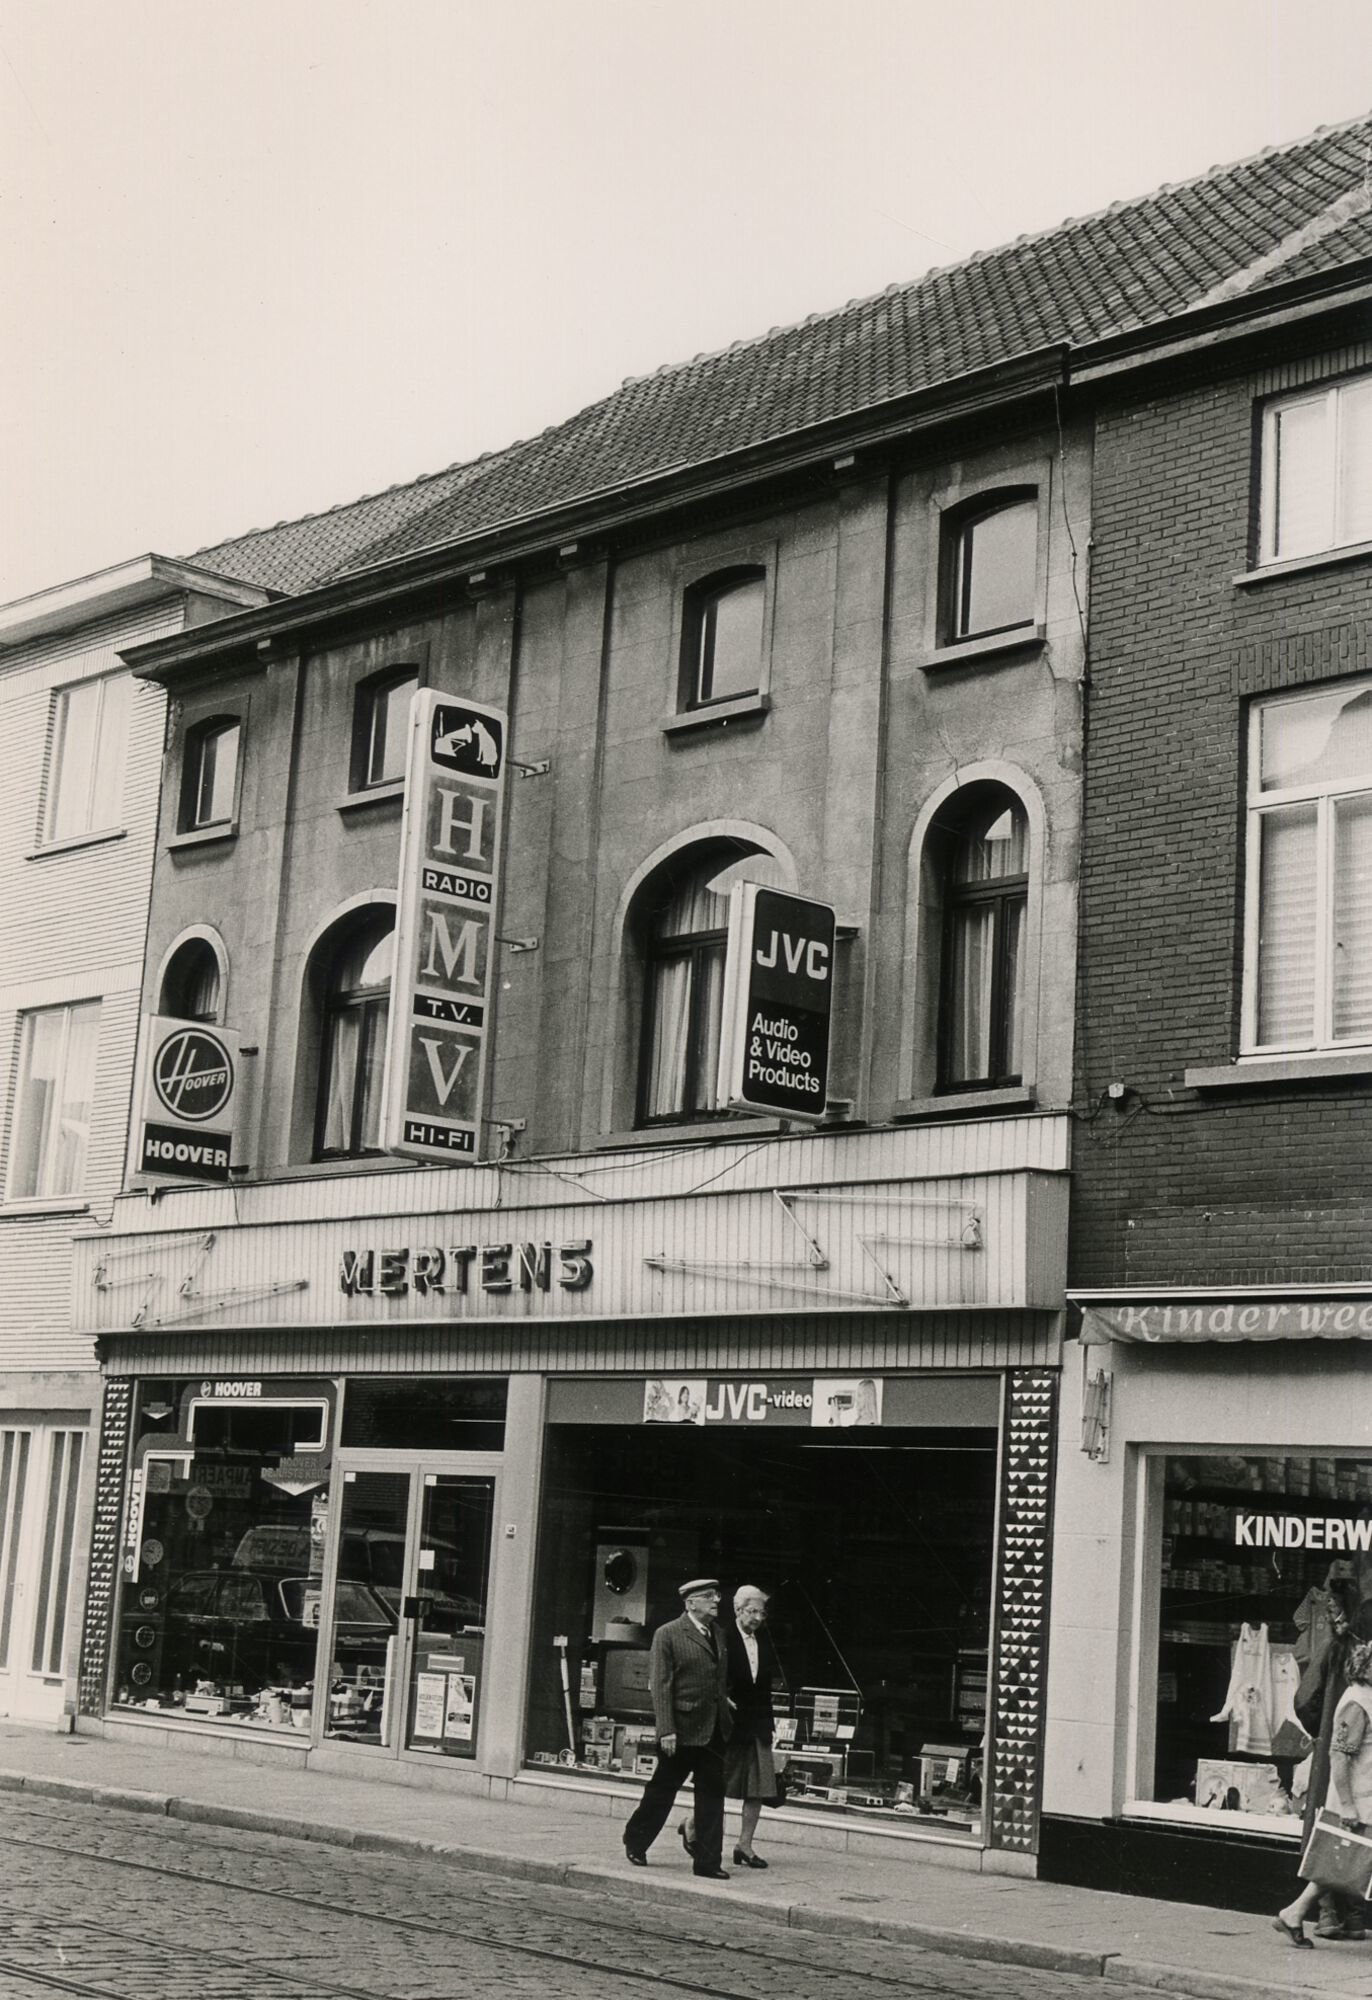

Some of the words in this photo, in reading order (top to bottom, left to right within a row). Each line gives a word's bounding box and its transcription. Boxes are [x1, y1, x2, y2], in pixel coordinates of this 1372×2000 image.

[433, 787, 490, 861] H
[425, 871, 489, 900] RADIO
[421, 910, 484, 985] M
[756, 930, 829, 981] JVC
[427, 999, 471, 1023] T.V.
[751, 1012, 798, 1042] Audio
[750, 1035, 763, 1058] &
[765, 1039, 812, 1068] Video
[419, 1037, 474, 1105] V
[748, 1059, 821, 1094] Products
[145, 1139, 228, 1167] HOOVER
[410, 1124, 469, 1149] HI-FI
[339, 1239, 594, 1297] MERTENS
[214, 1381, 262, 1397] HOOVER
[1235, 1515, 1372, 1551] KINDERW
